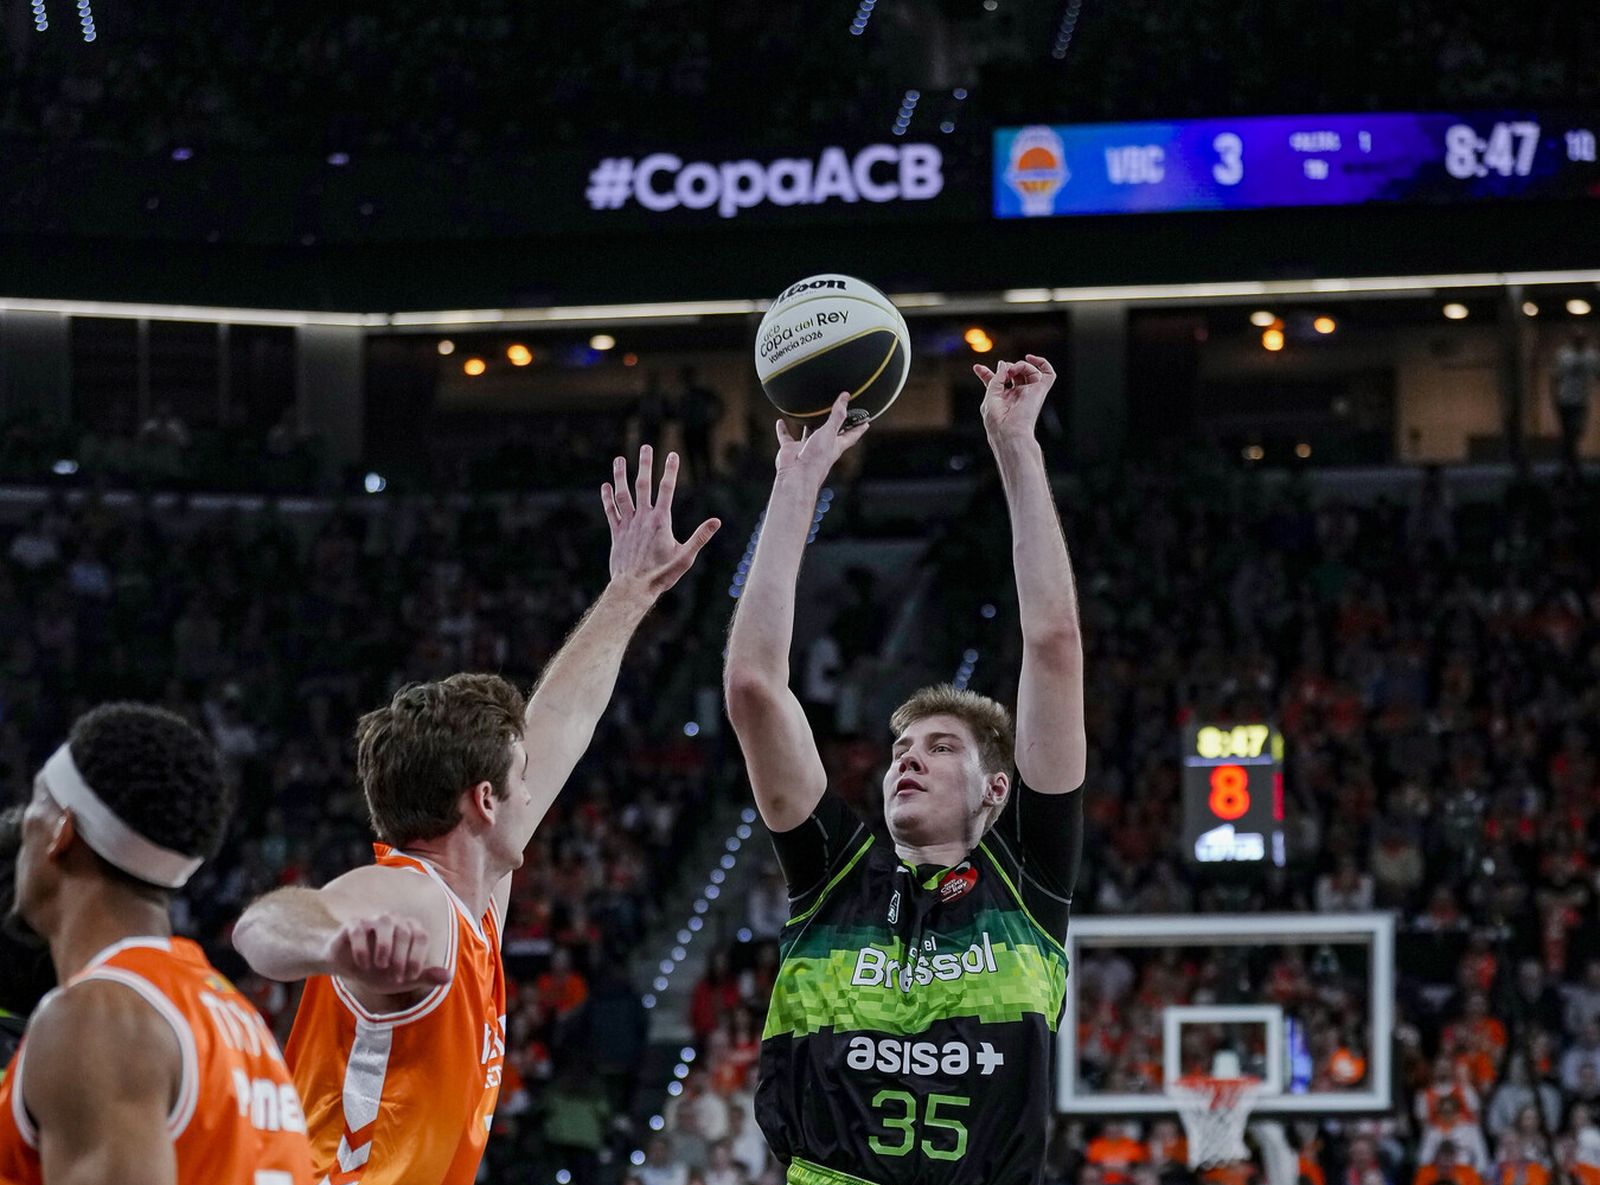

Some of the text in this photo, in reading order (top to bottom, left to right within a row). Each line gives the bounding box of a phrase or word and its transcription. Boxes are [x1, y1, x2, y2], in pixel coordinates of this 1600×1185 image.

[1212, 132, 1243, 185] 3
[1445, 121, 1541, 179] 8:47
[586, 143, 944, 217] #CopaACB
[800, 330, 823, 345] 2026
[816, 311, 849, 327] Rey
[1208, 763, 1251, 820] 8
[847, 1036, 970, 1076] asisa
[868, 1089, 971, 1161] 35
